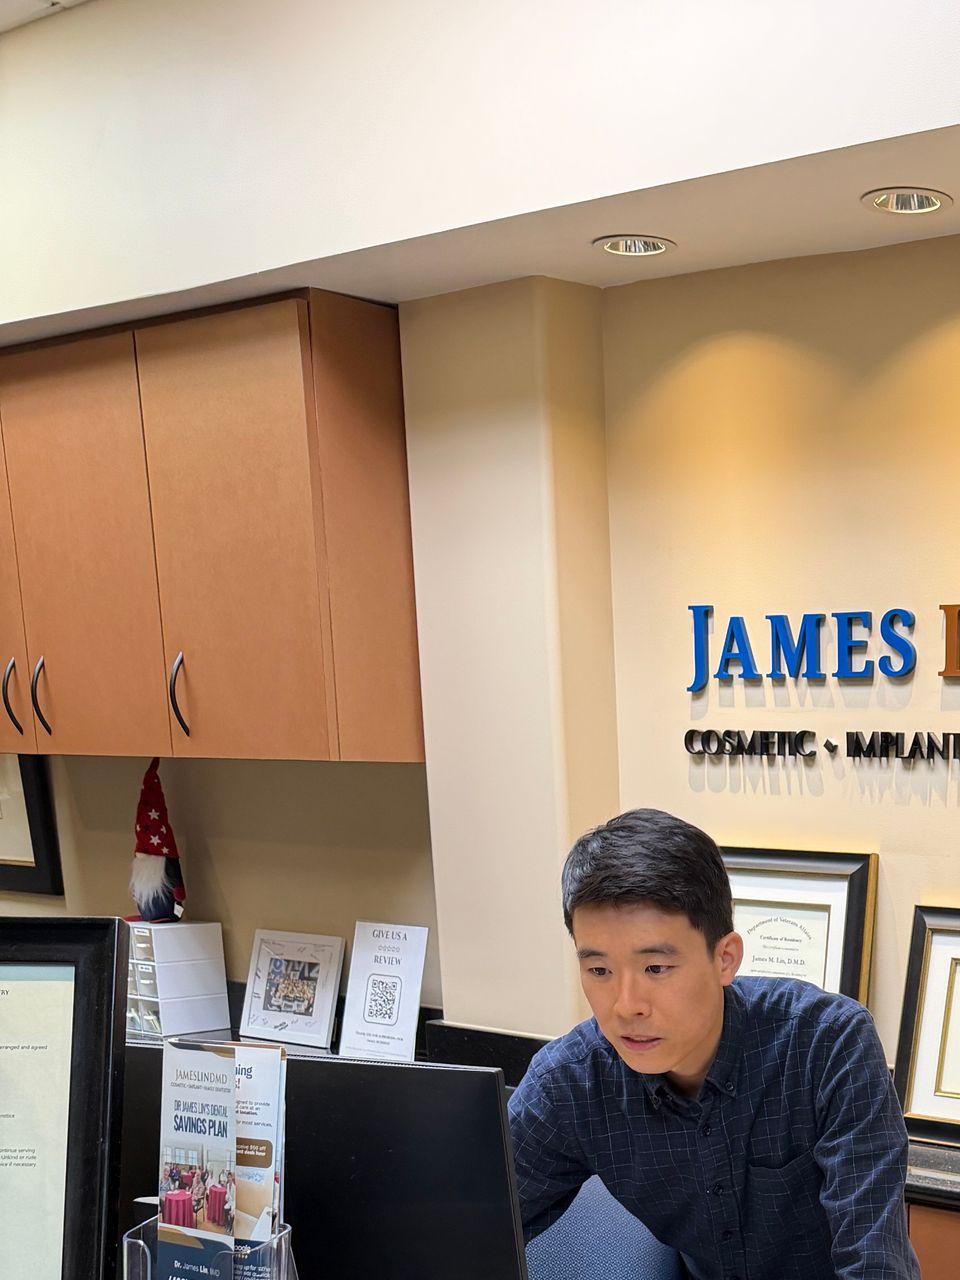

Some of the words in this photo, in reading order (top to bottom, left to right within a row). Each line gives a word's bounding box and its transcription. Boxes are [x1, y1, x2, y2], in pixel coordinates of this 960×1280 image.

[687, 604, 917, 693] JAMES
[684, 729, 816, 757] COSMETIC
[372, 929, 390, 940] GIVE
[391, 930, 401, 941] US
[402, 932, 408, 941] A
[374, 955, 402, 966] REVIEW
[208, 1119, 228, 1138] PLAN
[174, 1260, 182, 1269] Dr.
[182, 1262, 200, 1272] James
